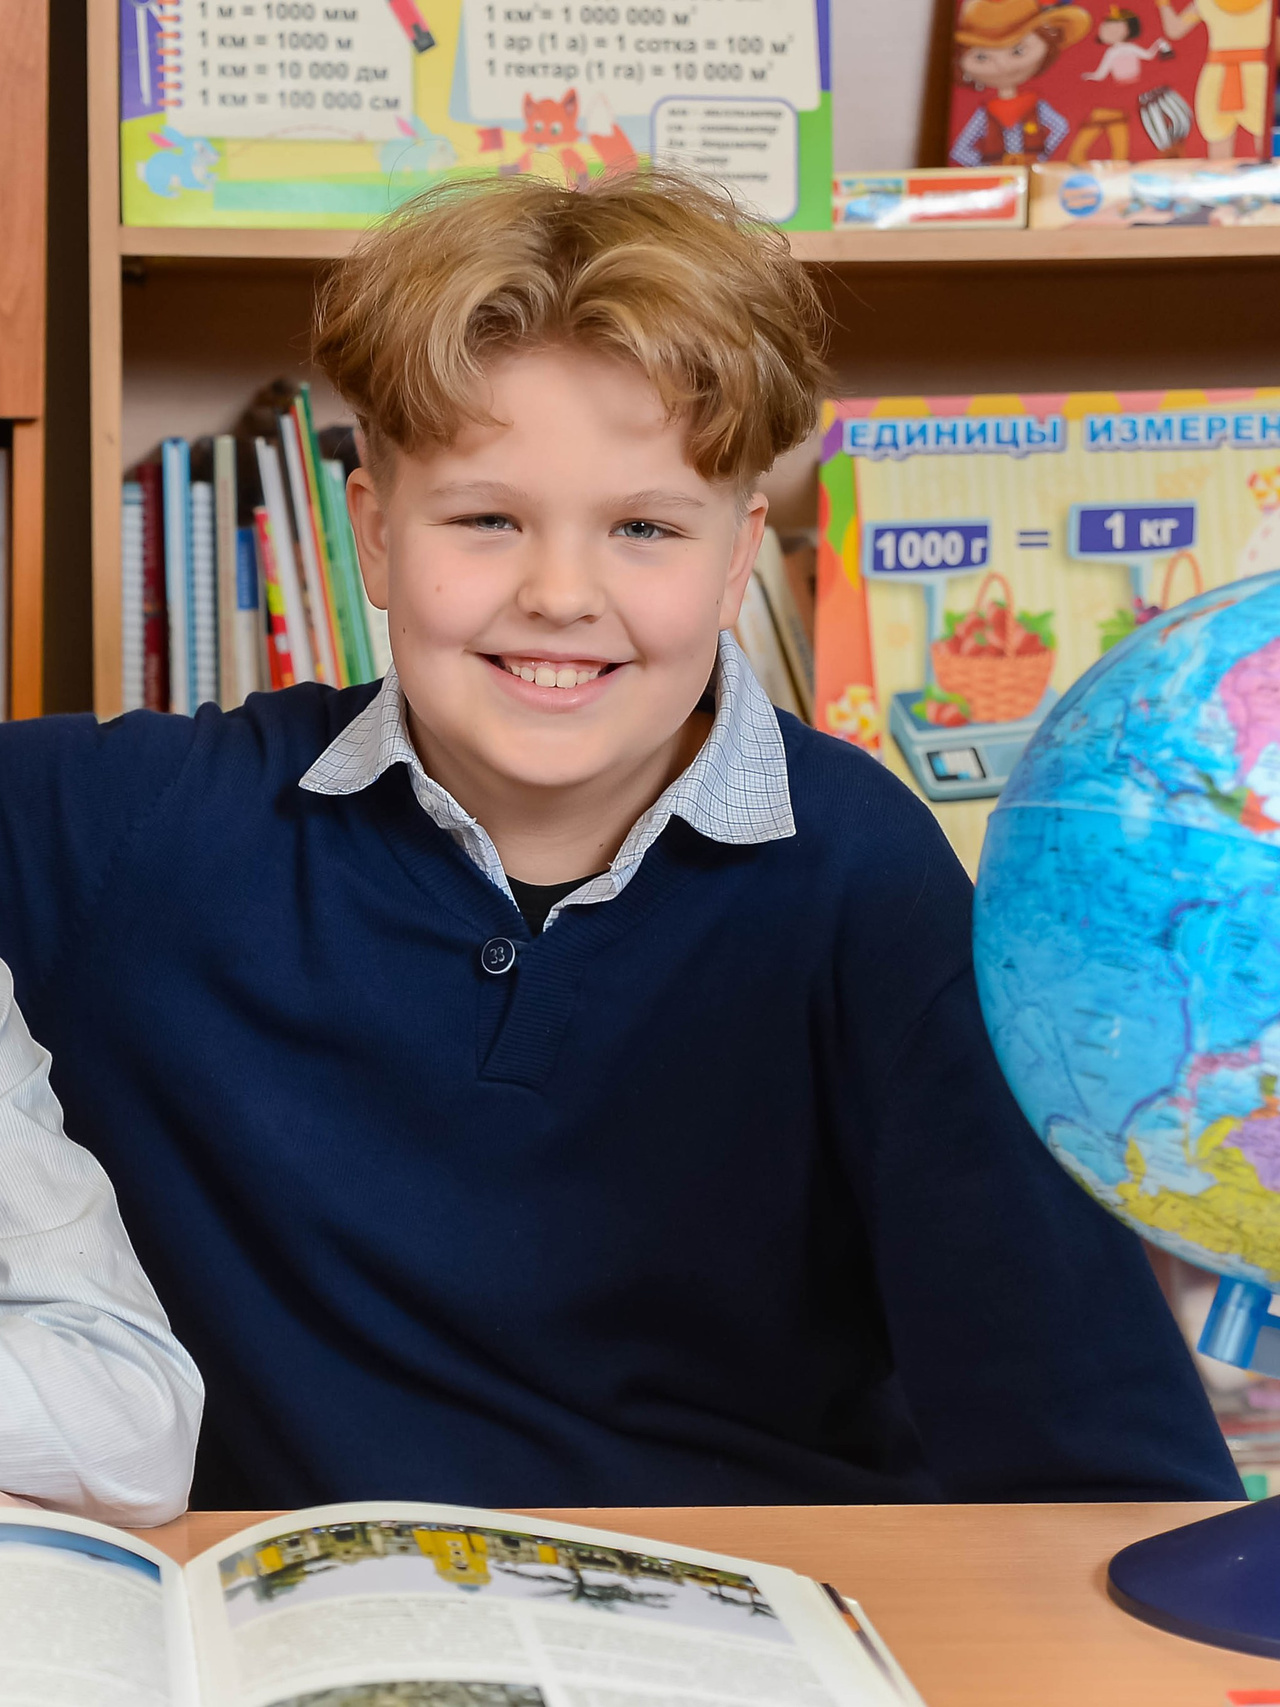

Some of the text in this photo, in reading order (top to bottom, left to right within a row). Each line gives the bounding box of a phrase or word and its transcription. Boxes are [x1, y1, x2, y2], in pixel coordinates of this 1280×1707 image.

[265, 2, 316, 21] 1000
[323, 9, 358, 22] мм
[486, 5, 495, 22] 1
[563, 6, 571, 24] 1
[580, 5, 620, 25] 000
[627, 6, 665, 26] 000
[199, 30, 208, 48] 1
[218, 36, 247, 49] км
[278, 32, 328, 50] 1000
[336, 38, 352, 50] м
[486, 32, 495, 49] 1
[505, 36, 532, 53] ар
[539, 32, 557, 55] (1
[567, 33, 588, 56] а)
[617, 34, 626, 52] 1
[634, 38, 697, 54] сотка
[727, 36, 763, 54] 100
[199, 60, 208, 77] 1
[218, 65, 248, 78] км
[278, 61, 302, 80] 10
[309, 62, 349, 80] 000
[355, 67, 388, 83] дм
[486, 59, 495, 76] 1
[505, 63, 579, 81] гектар
[586, 60, 605, 84] (1
[613, 62, 645, 85] га)
[674, 61, 698, 81] 10
[704, 63, 743, 82] 000
[199, 89, 208, 106] 1
[218, 94, 248, 107] км
[278, 91, 316, 109] 100
[323, 92, 363, 110] 000
[369, 97, 401, 111] см
[851, 414, 1280, 451] ЕДИНИЦЫ ИЗМЕРЕН
[875, 529, 965, 570] 1000
[970, 536, 988, 565] г
[1104, 510, 1126, 550] 1
[1139, 517, 1180, 548] кг
